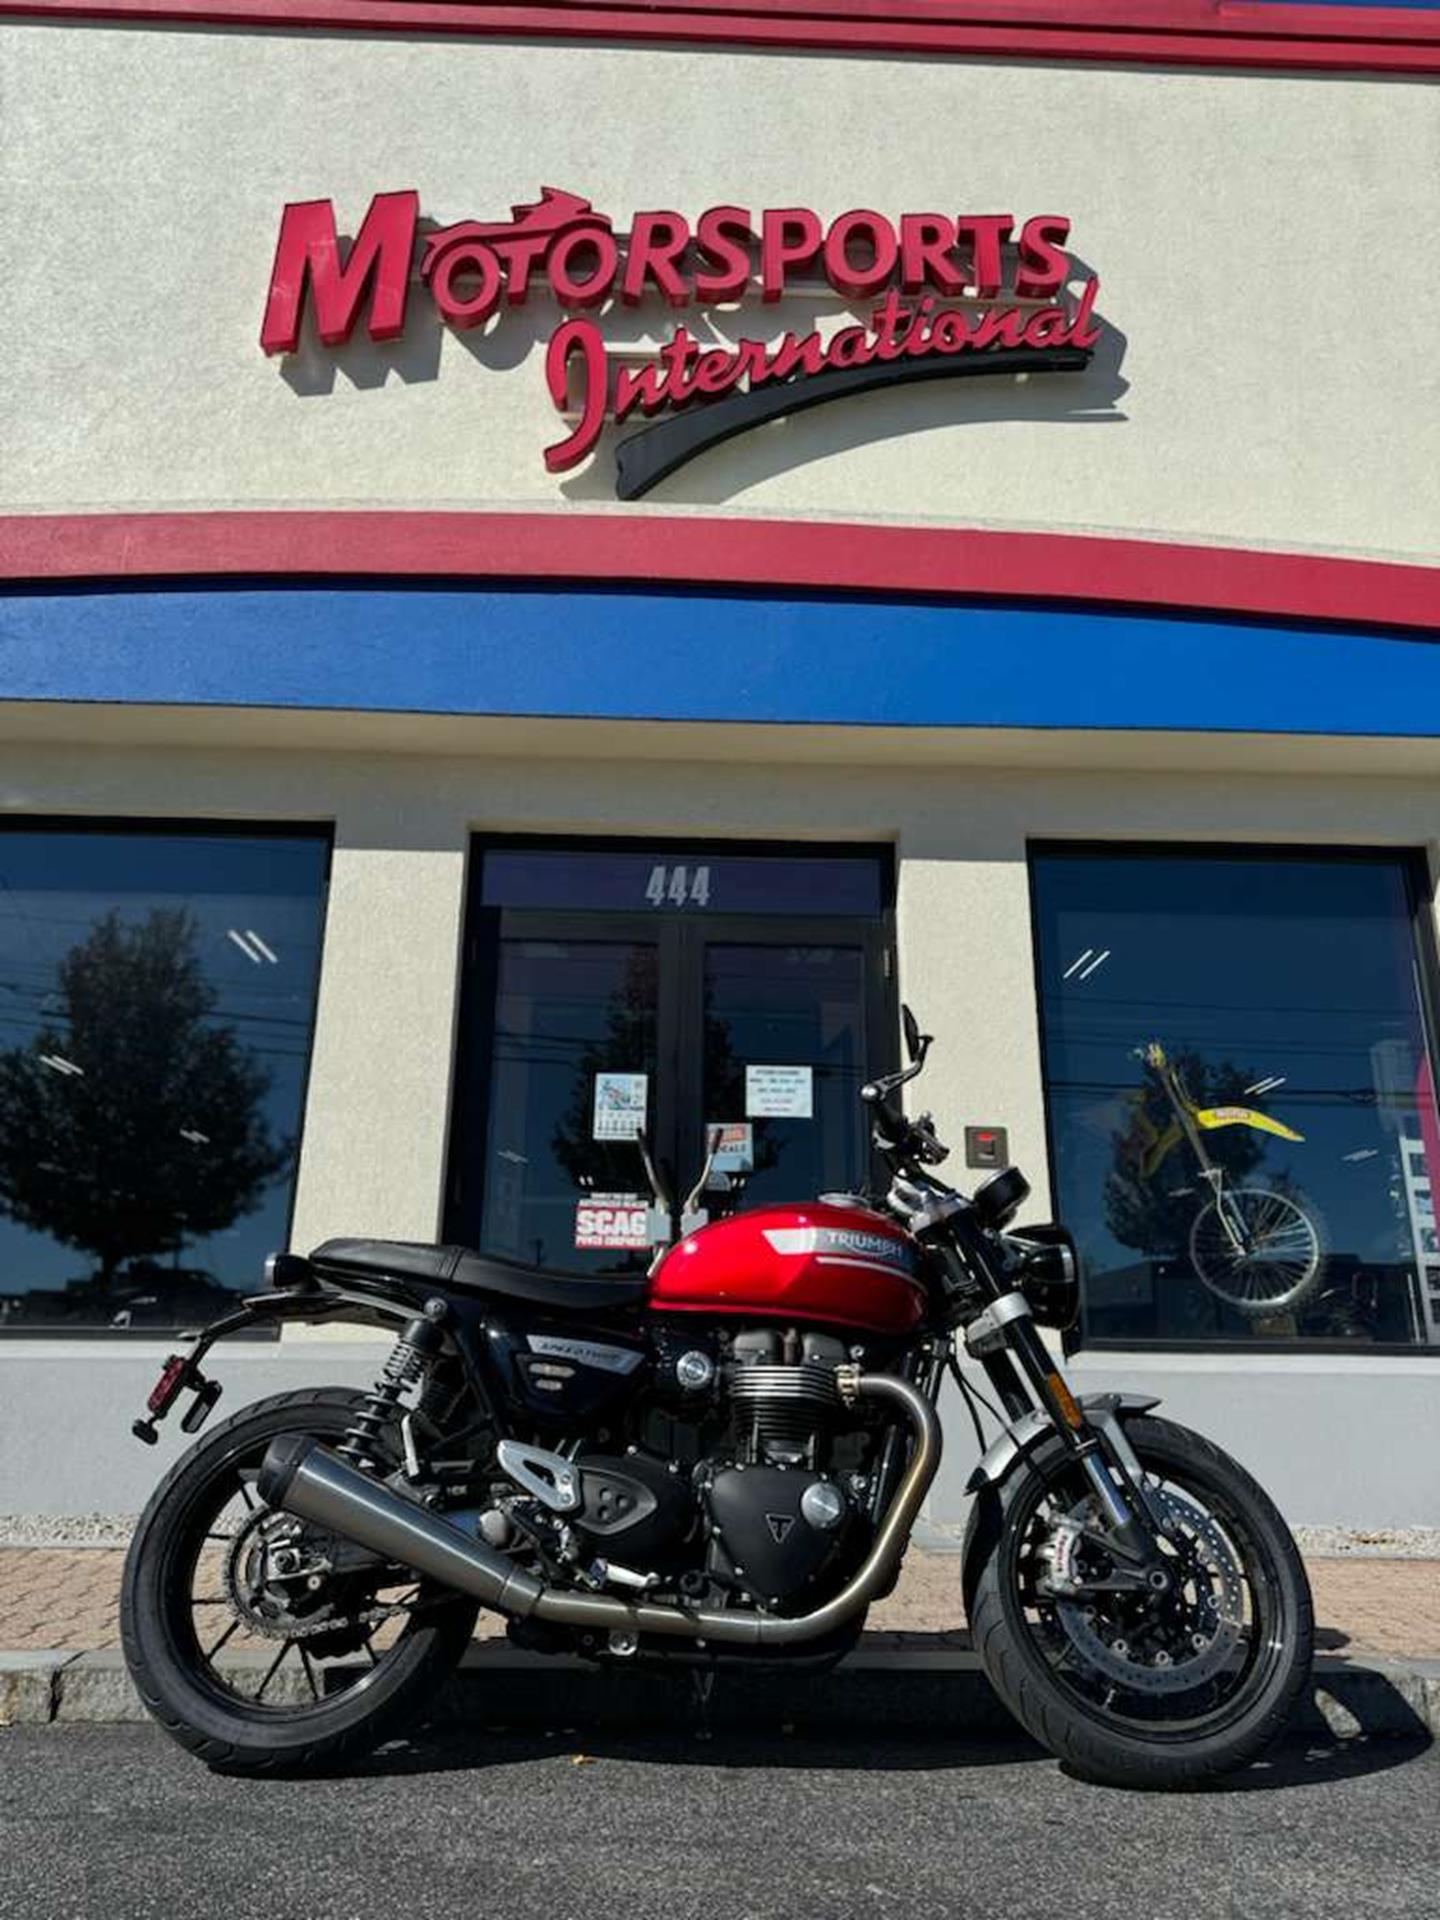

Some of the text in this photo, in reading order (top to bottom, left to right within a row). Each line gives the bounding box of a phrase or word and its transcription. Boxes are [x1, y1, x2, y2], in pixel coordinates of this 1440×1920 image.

[543, 276, 1101, 474] International
[644, 866, 710, 907] 444
[576, 1210, 647, 1236] SCAG
[827, 1231, 904, 1259] TRIUMPH
